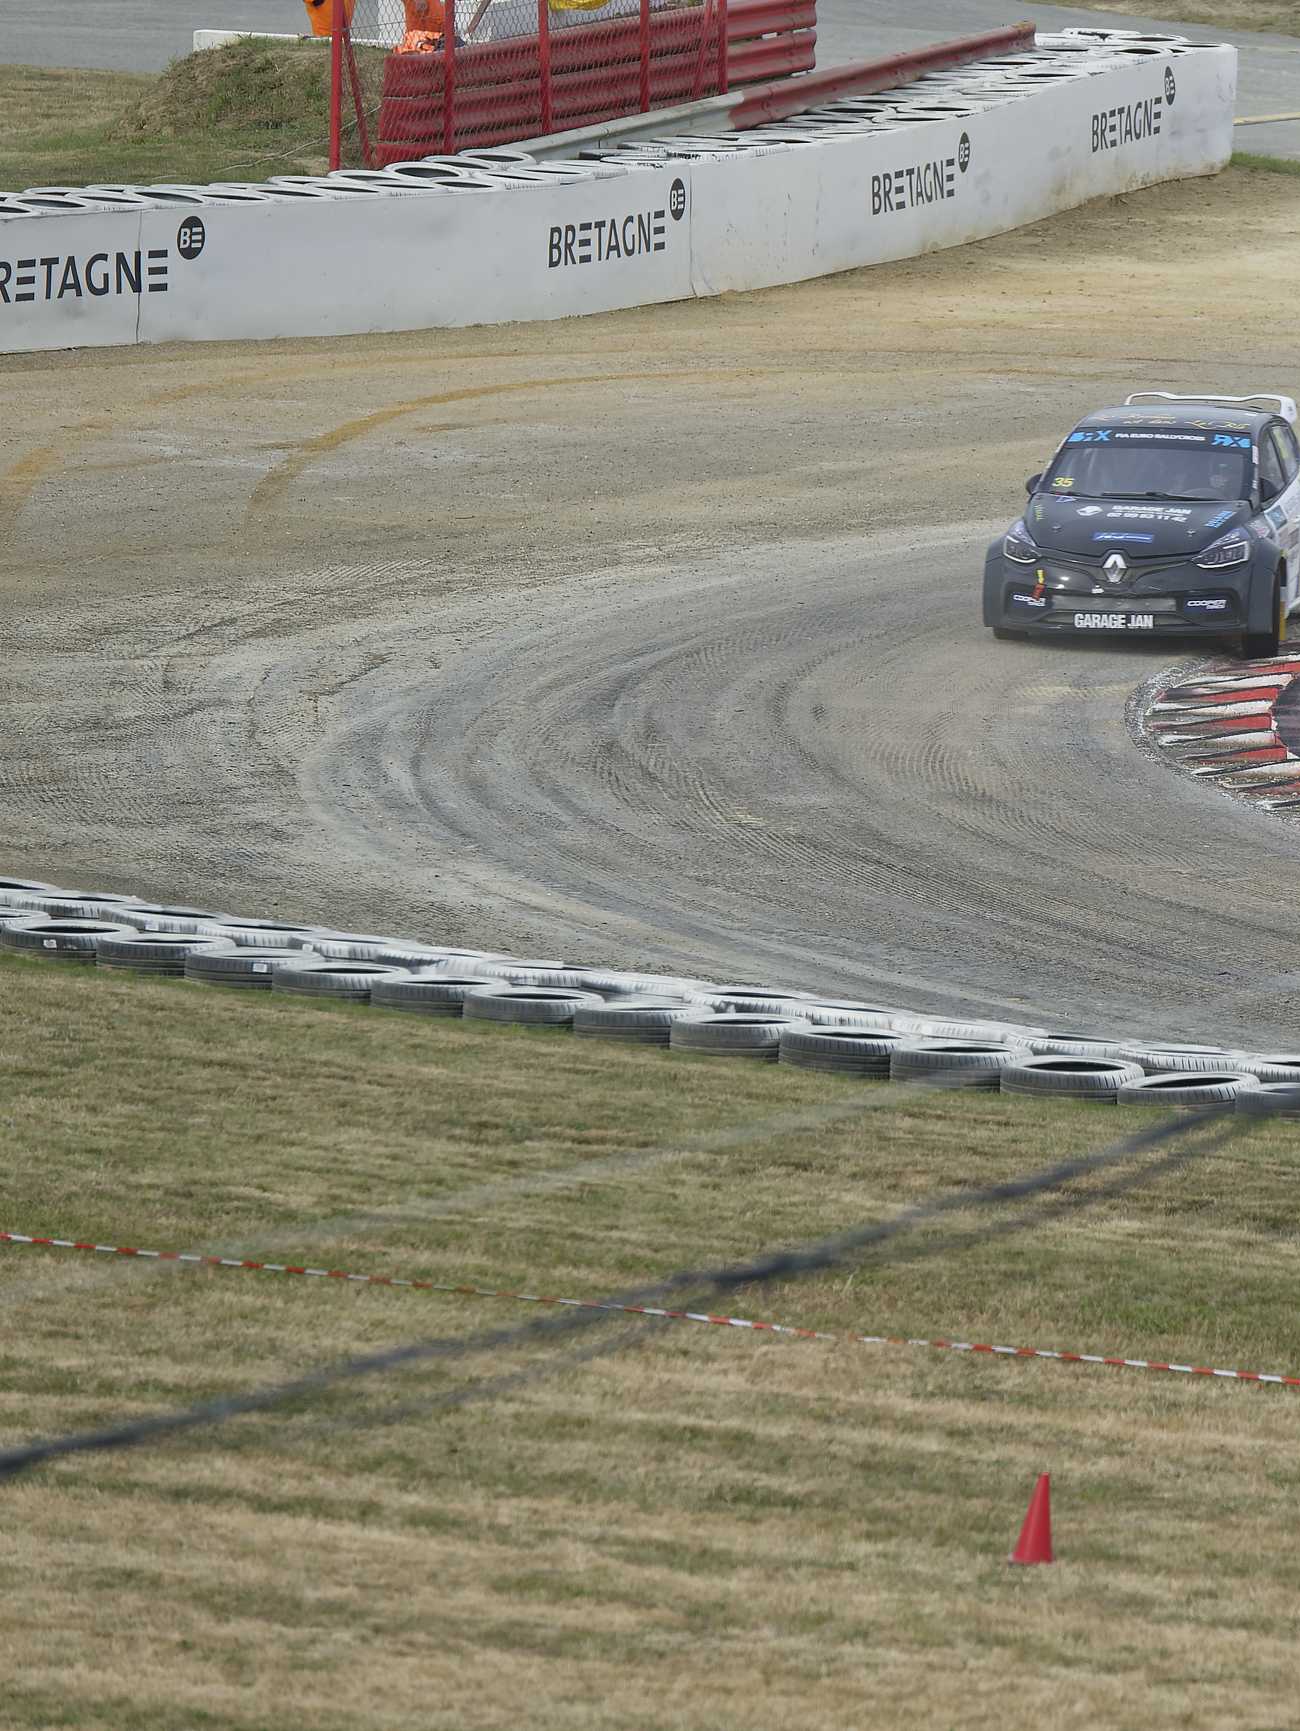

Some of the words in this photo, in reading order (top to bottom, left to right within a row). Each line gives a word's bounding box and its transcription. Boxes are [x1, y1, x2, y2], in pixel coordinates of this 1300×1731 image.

[1091, 96, 1163, 153] BRETAGNE
[871, 157, 955, 216] BRETAGNE
[548, 209, 666, 269] BRETAGNE
[1052, 477, 1075, 488] 35
[1074, 613, 1126, 629] GARAGE
[1127, 614, 1154, 629] JAN
